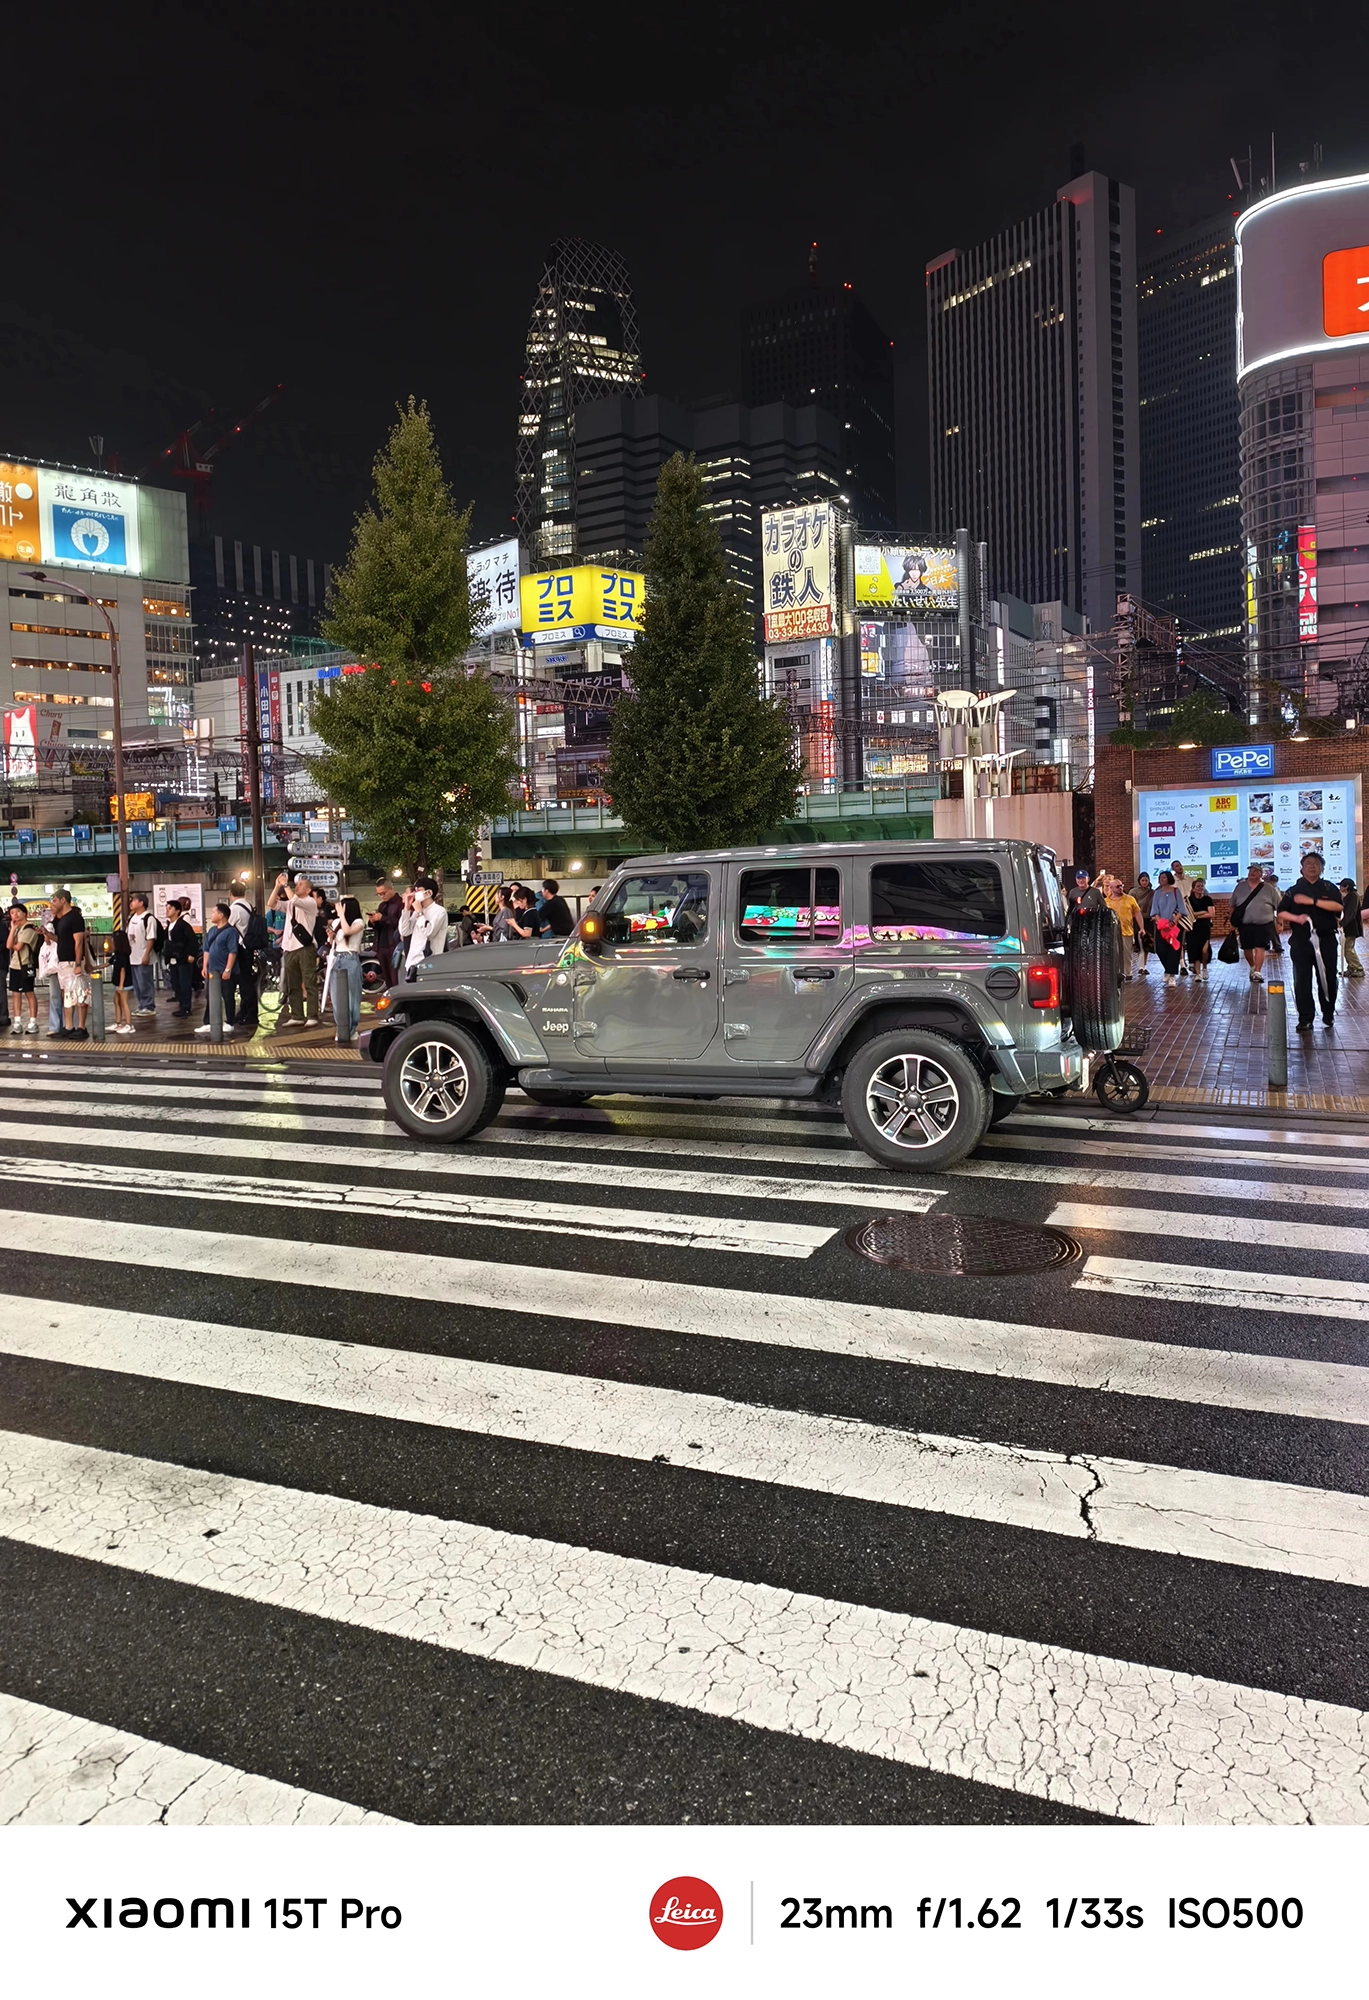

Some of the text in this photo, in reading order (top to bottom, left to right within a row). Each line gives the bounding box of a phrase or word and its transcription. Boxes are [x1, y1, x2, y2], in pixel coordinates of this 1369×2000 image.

[55, 483, 122, 508] 龍角散
[764, 506, 827, 556] カラオケ
[788, 547, 804, 572] の
[471, 569, 516, 606] 楽待
[537, 574, 574, 599] プロ
[601, 573, 635, 599] プロ
[770, 566, 824, 609] 鉄人
[538, 600, 574, 623] ミス
[602, 598, 636, 622] ミス
[892, 596, 958, 608] たいせい先生
[40, 709, 63, 719] Churu
[1217, 751, 1270, 769] PePe
[1215, 797, 1231, 805] ABC
[1155, 848, 1170, 856] GU
[542, 1021, 569, 1034] Jeep
